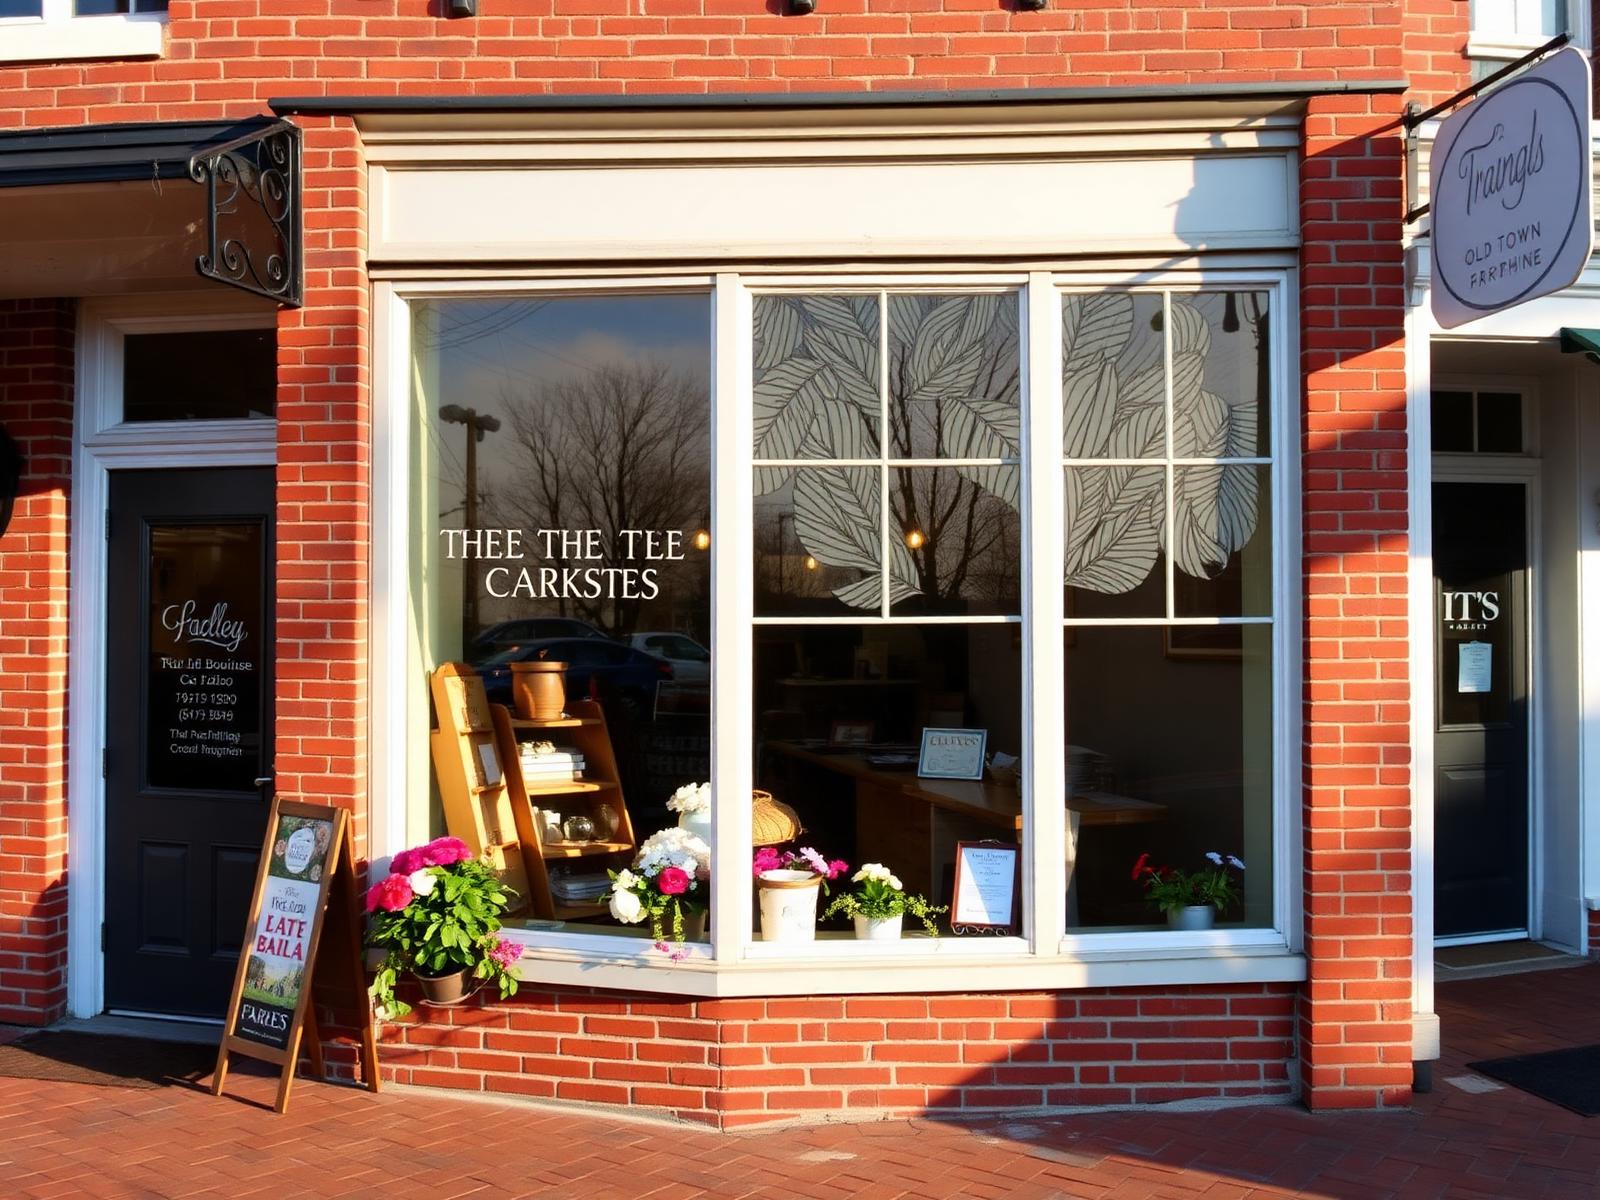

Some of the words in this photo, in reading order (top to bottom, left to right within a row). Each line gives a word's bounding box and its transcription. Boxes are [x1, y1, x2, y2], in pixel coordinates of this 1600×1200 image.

[1464, 241, 1493, 266] OLD
[1496, 221, 1542, 251] TOWN
[439, 529, 525, 560] THEE
[537, 529, 604, 560] THE
[619, 530, 686, 561] TEE
[485, 567, 660, 600] CARKSTES
[1442, 591, 1499, 621] IT'S
[265, 914, 307, 939] LATE
[256, 934, 303, 961] BAILA
